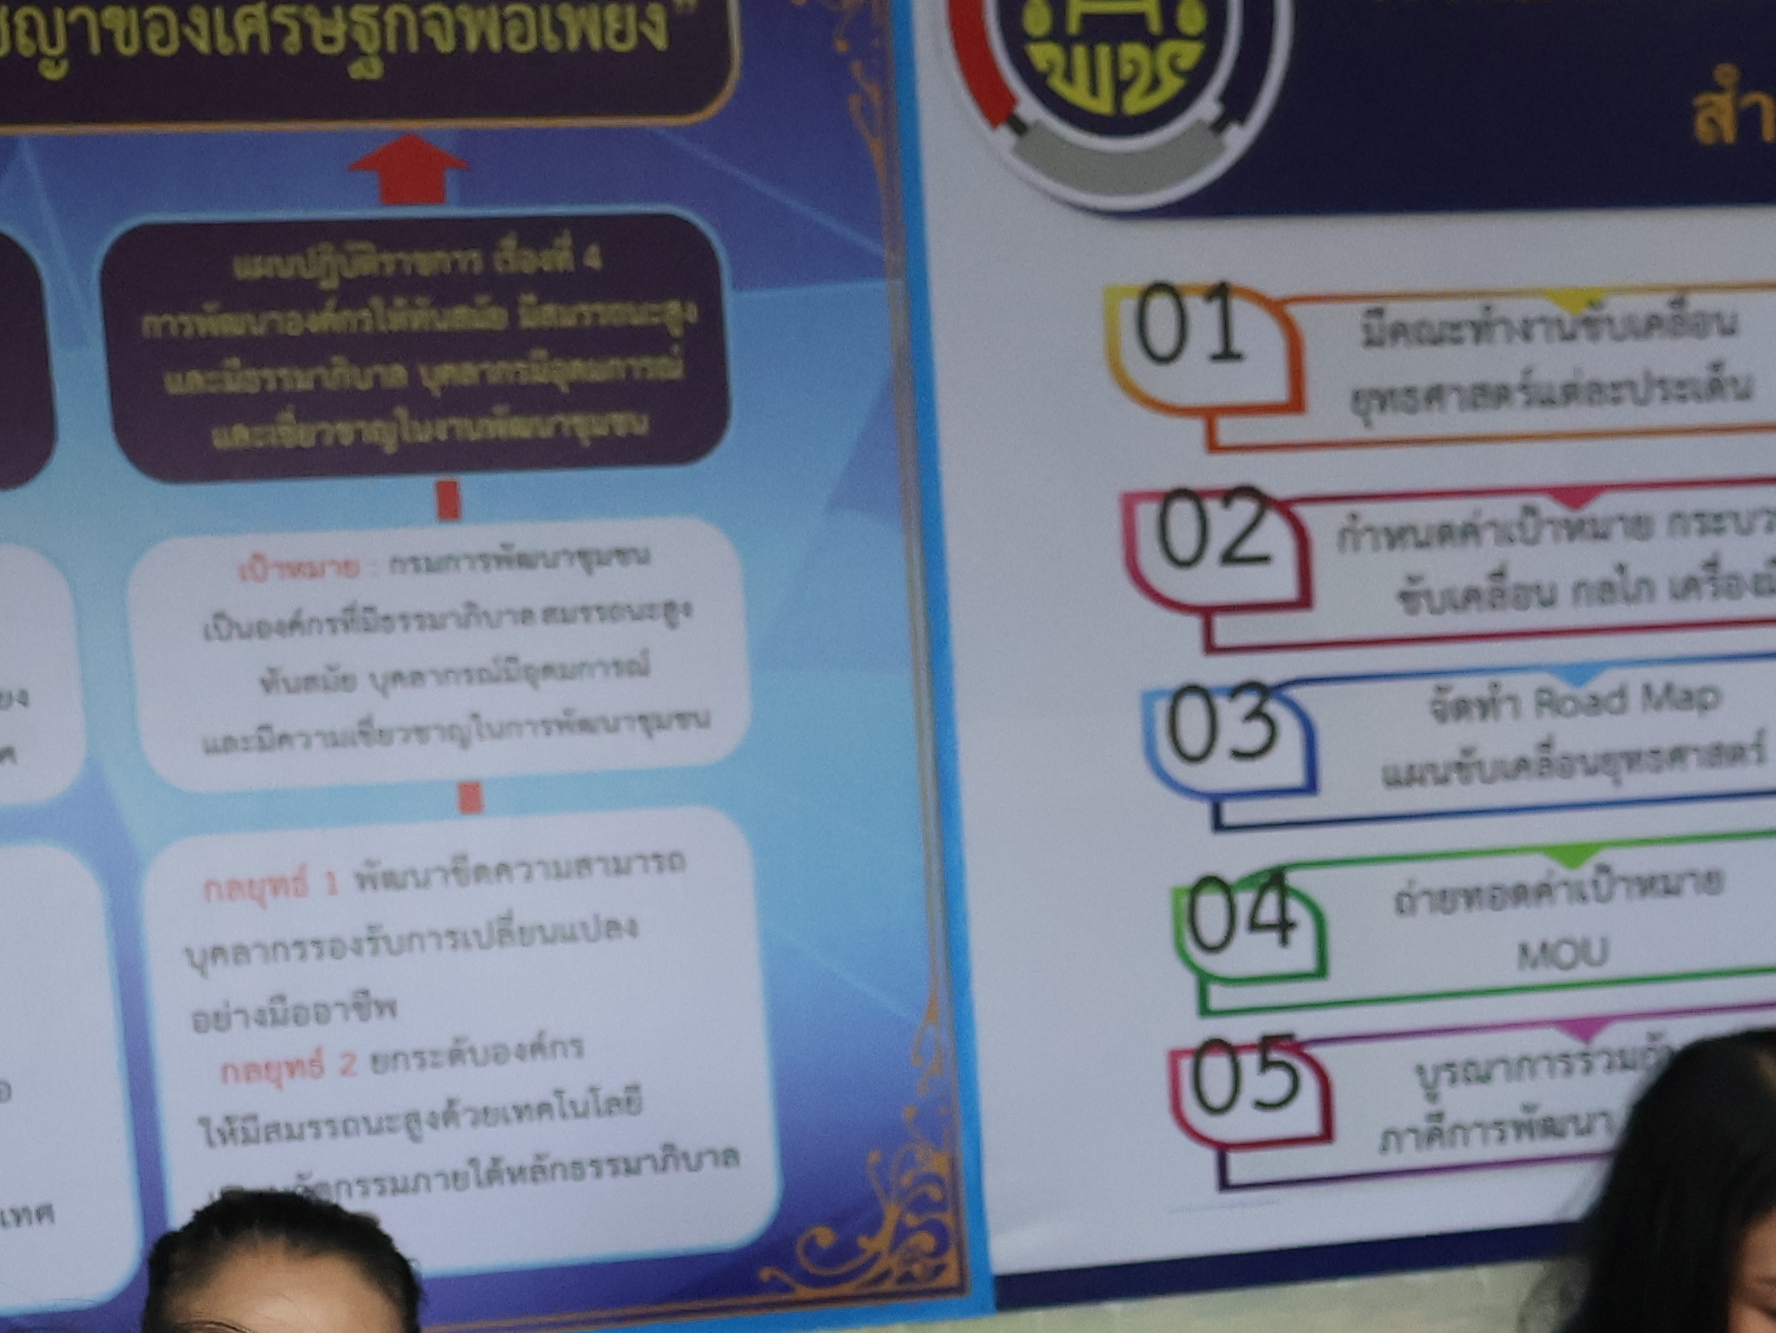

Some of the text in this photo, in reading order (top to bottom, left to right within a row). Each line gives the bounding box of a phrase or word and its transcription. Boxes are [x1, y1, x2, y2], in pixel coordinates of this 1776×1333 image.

[1136, 281, 1246, 366] 01
[1157, 486, 1274, 569] 02
[1167, 680, 1279, 765] 03
[1535, 682, 1627, 718] Road
[1641, 680, 1721, 720] Map
[204, 863, 310, 909] กลยุทธ์
[325, 870, 338, 895] 1
[1186, 868, 1297, 955] 04
[1518, 934, 1609, 974] MOU
[220, 1047, 325, 1090] กลยุทธ์
[339, 1053, 357, 1076] 2
[1192, 1032, 1301, 1116] 05
